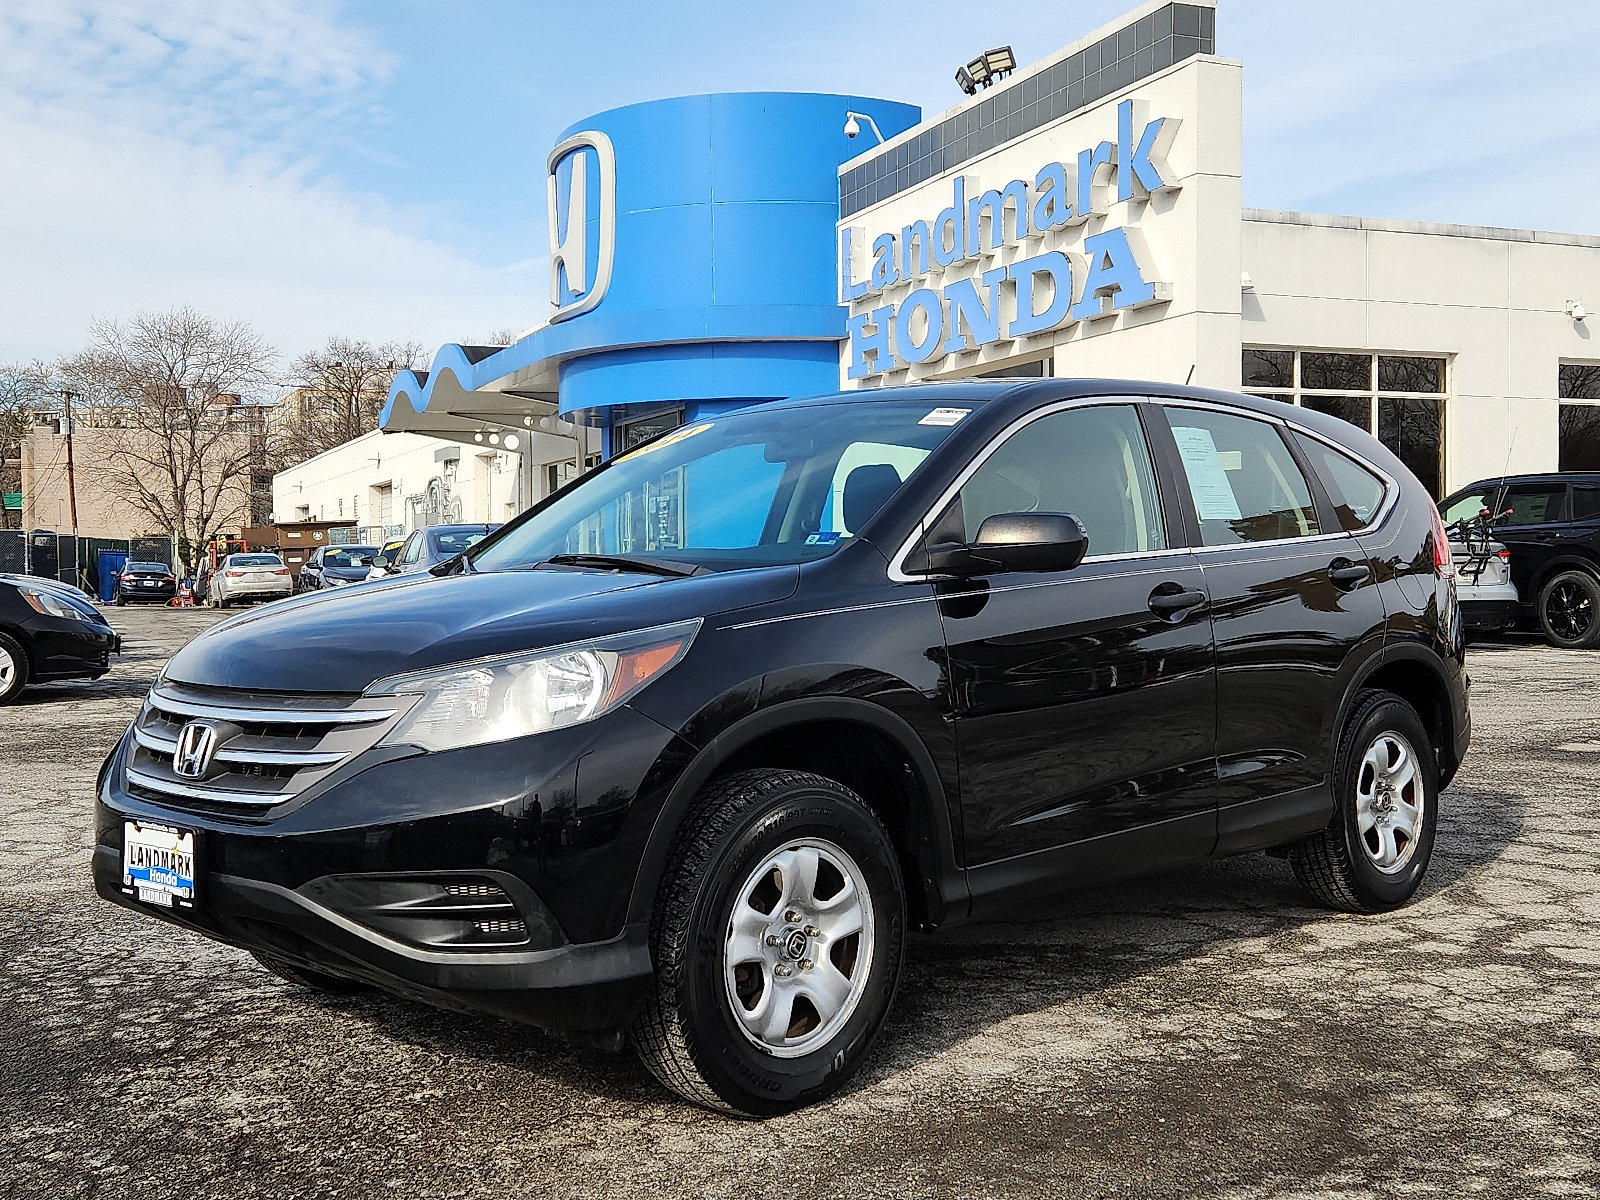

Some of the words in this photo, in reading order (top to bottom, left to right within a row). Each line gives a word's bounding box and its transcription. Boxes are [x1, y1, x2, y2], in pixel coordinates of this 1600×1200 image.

[841, 98, 1174, 303] Landmark
[846, 226, 1160, 380] HONDA
[129, 844, 192, 878] LANDMARK
[149, 868, 178, 887] Honda
